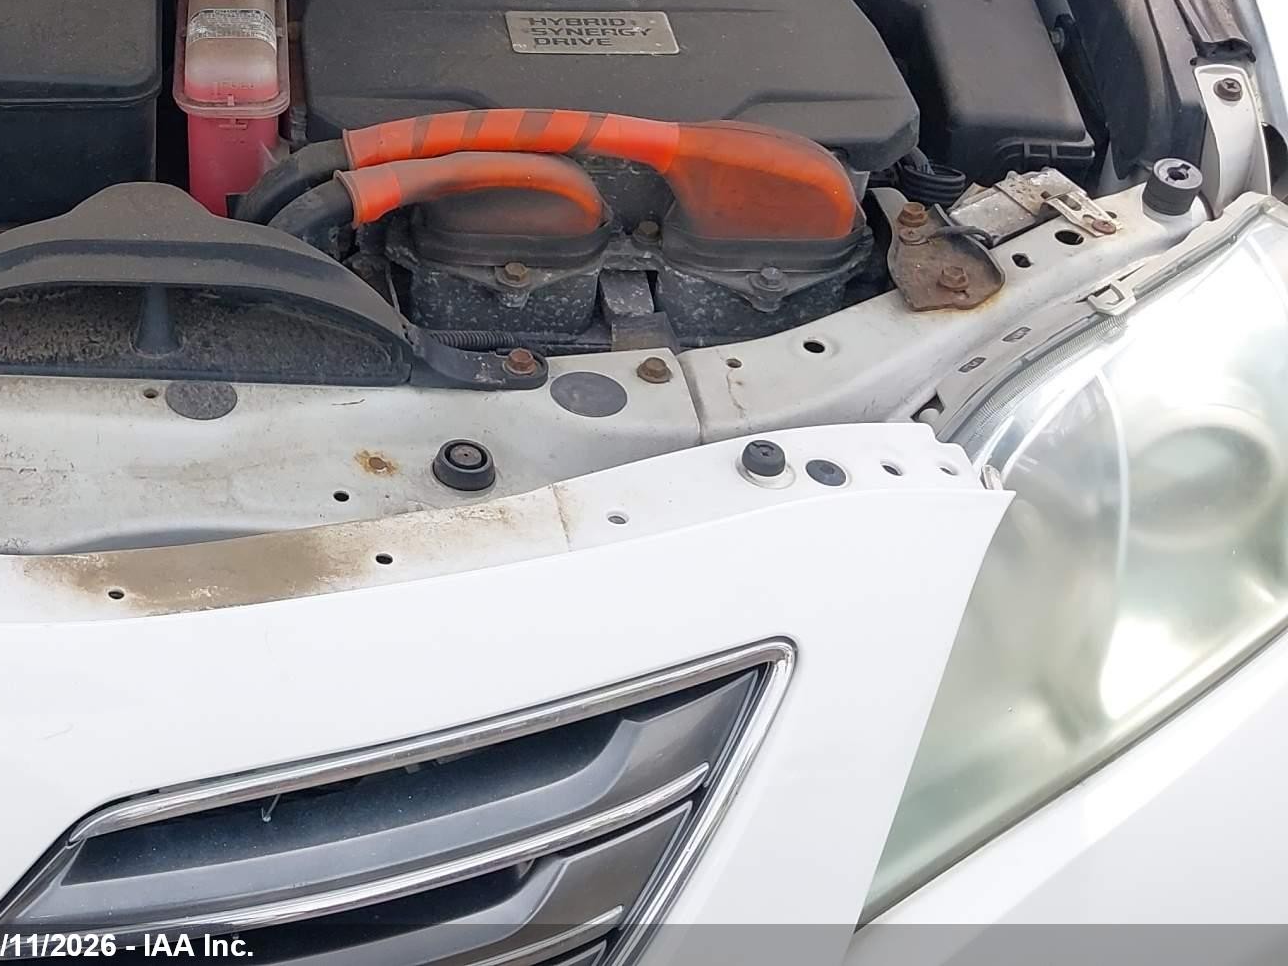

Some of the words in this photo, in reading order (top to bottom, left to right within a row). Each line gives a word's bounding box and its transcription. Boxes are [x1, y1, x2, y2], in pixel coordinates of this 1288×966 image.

[528, 18, 627, 26] HYBRID
[530, 27, 651, 37] SYNERGY
[534, 37, 614, 46] DRIVE
